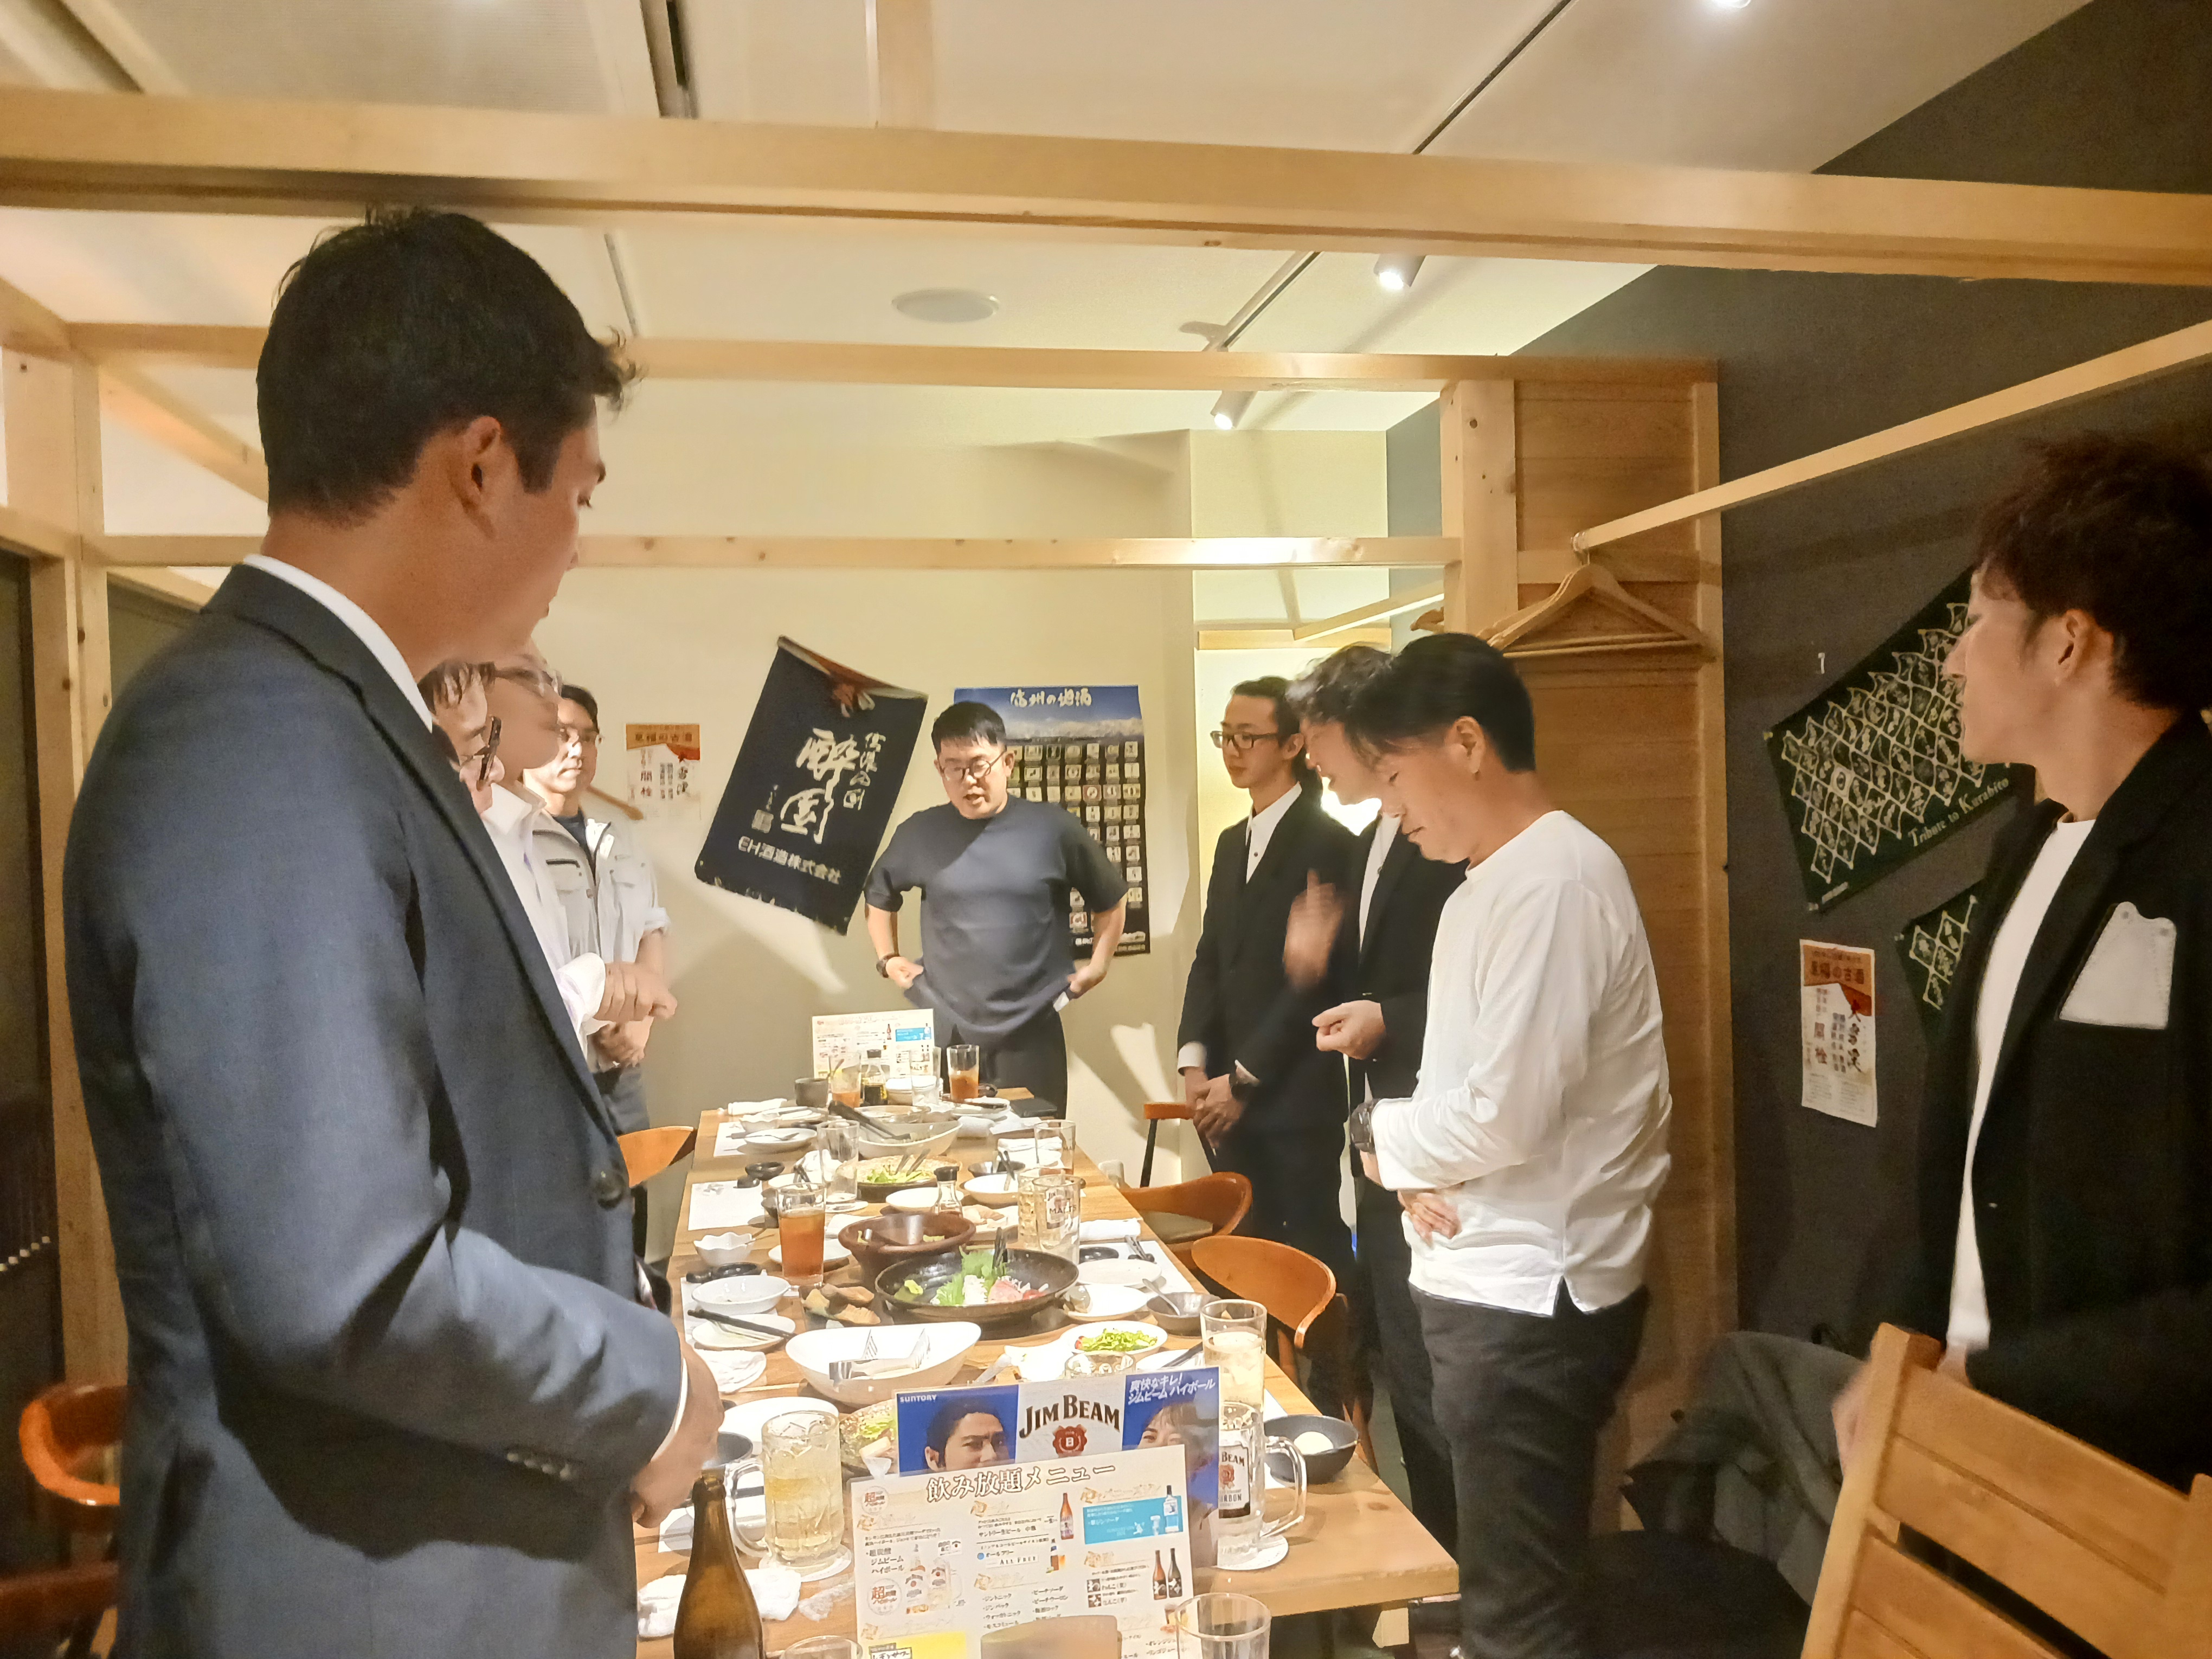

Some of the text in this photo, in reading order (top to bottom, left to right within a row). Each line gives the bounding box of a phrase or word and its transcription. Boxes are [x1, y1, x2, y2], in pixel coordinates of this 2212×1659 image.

[1908, 821, 1946, 847] Tribute
[1169, 1378, 1216, 1397] ハイボール
[899, 1394, 937, 1404] SUNTORY
[1019, 1394, 1121, 1439] JIM BEAM
[1221, 1451, 1245, 1467] BEAM
[927, 1464, 1115, 1503] 飲み放題メニュー
